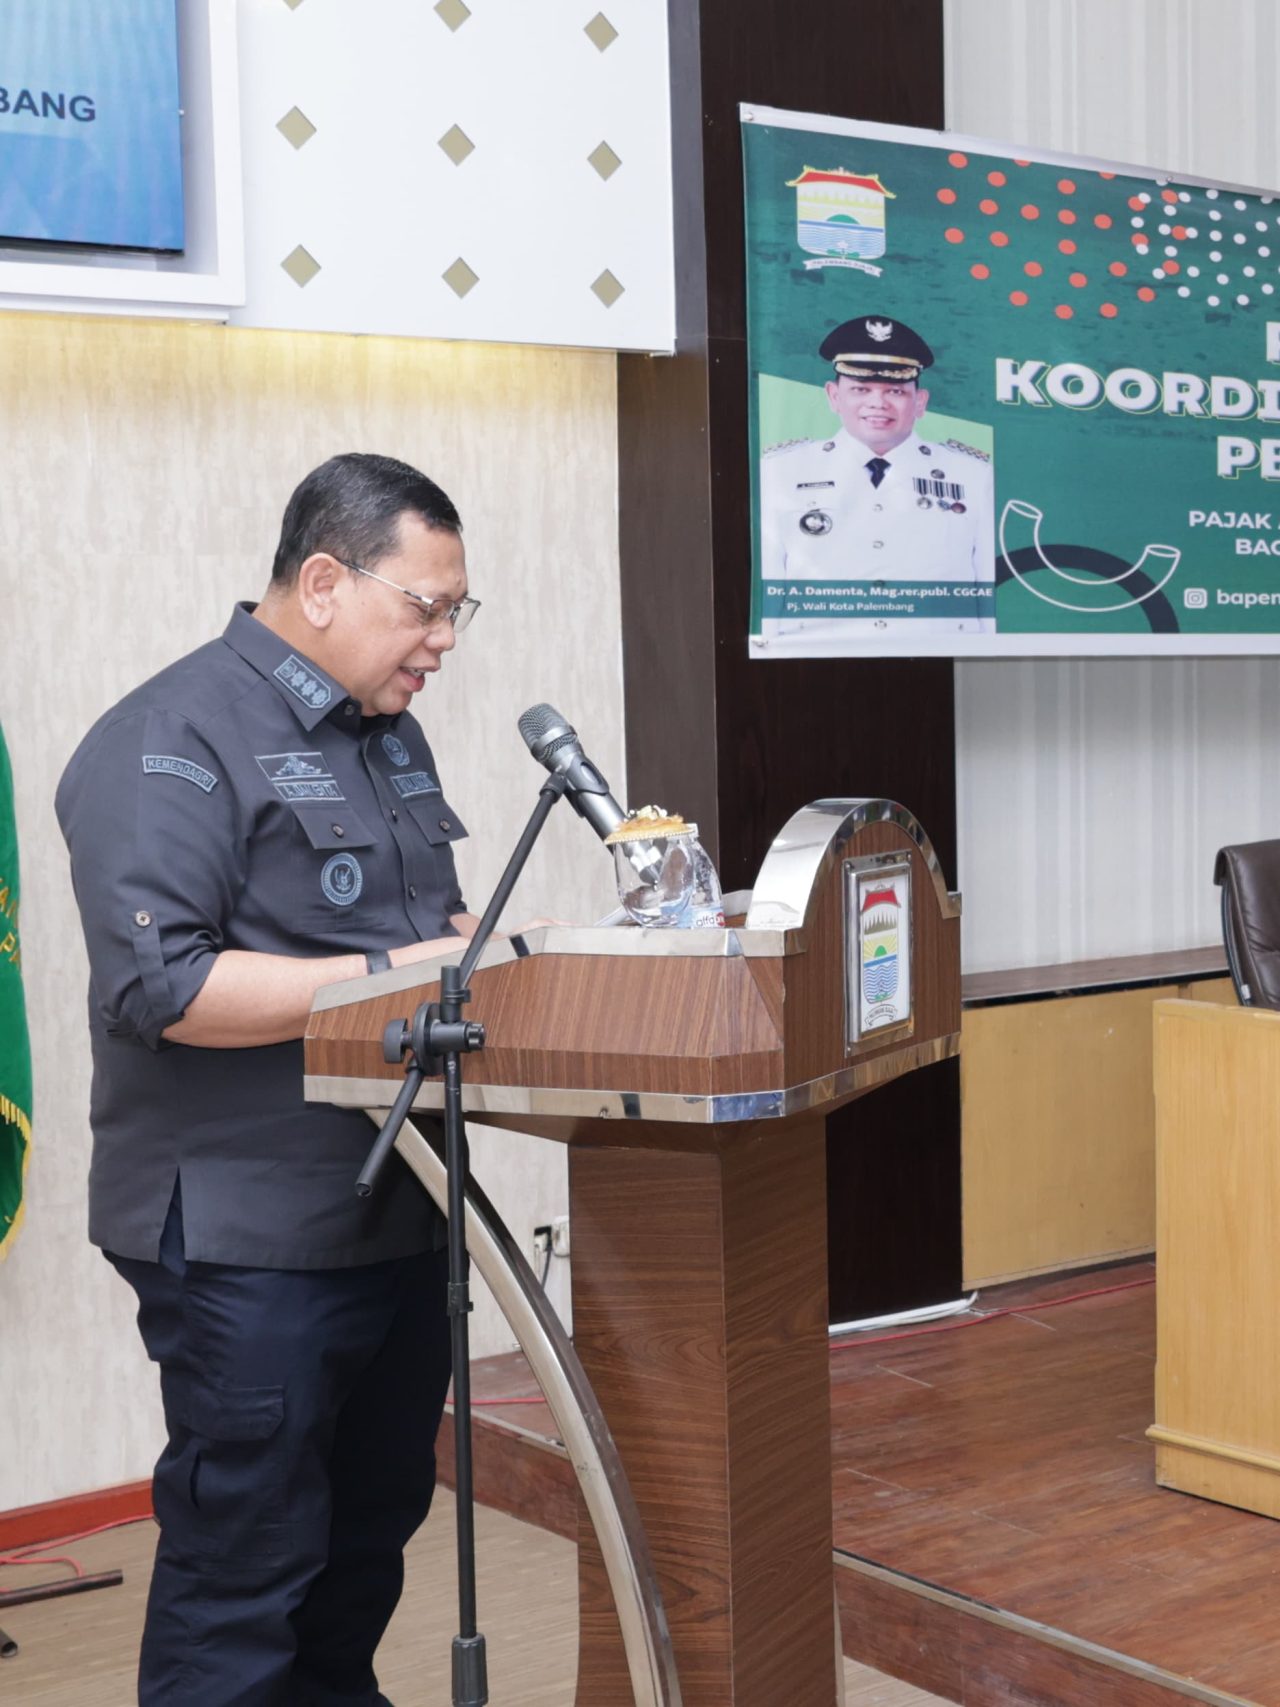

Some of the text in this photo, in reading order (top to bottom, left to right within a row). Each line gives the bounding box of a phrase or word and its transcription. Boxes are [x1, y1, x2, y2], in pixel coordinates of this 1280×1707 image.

[1188, 510, 1272, 530] PAJAK
[767, 586, 994, 599] Dr. A. Damenta, Mag.rer.publ. CGCAE
[786, 602, 915, 613] Pj. Wali Kota Palembang
[146, 757, 212, 789] KEMENDAGRI
